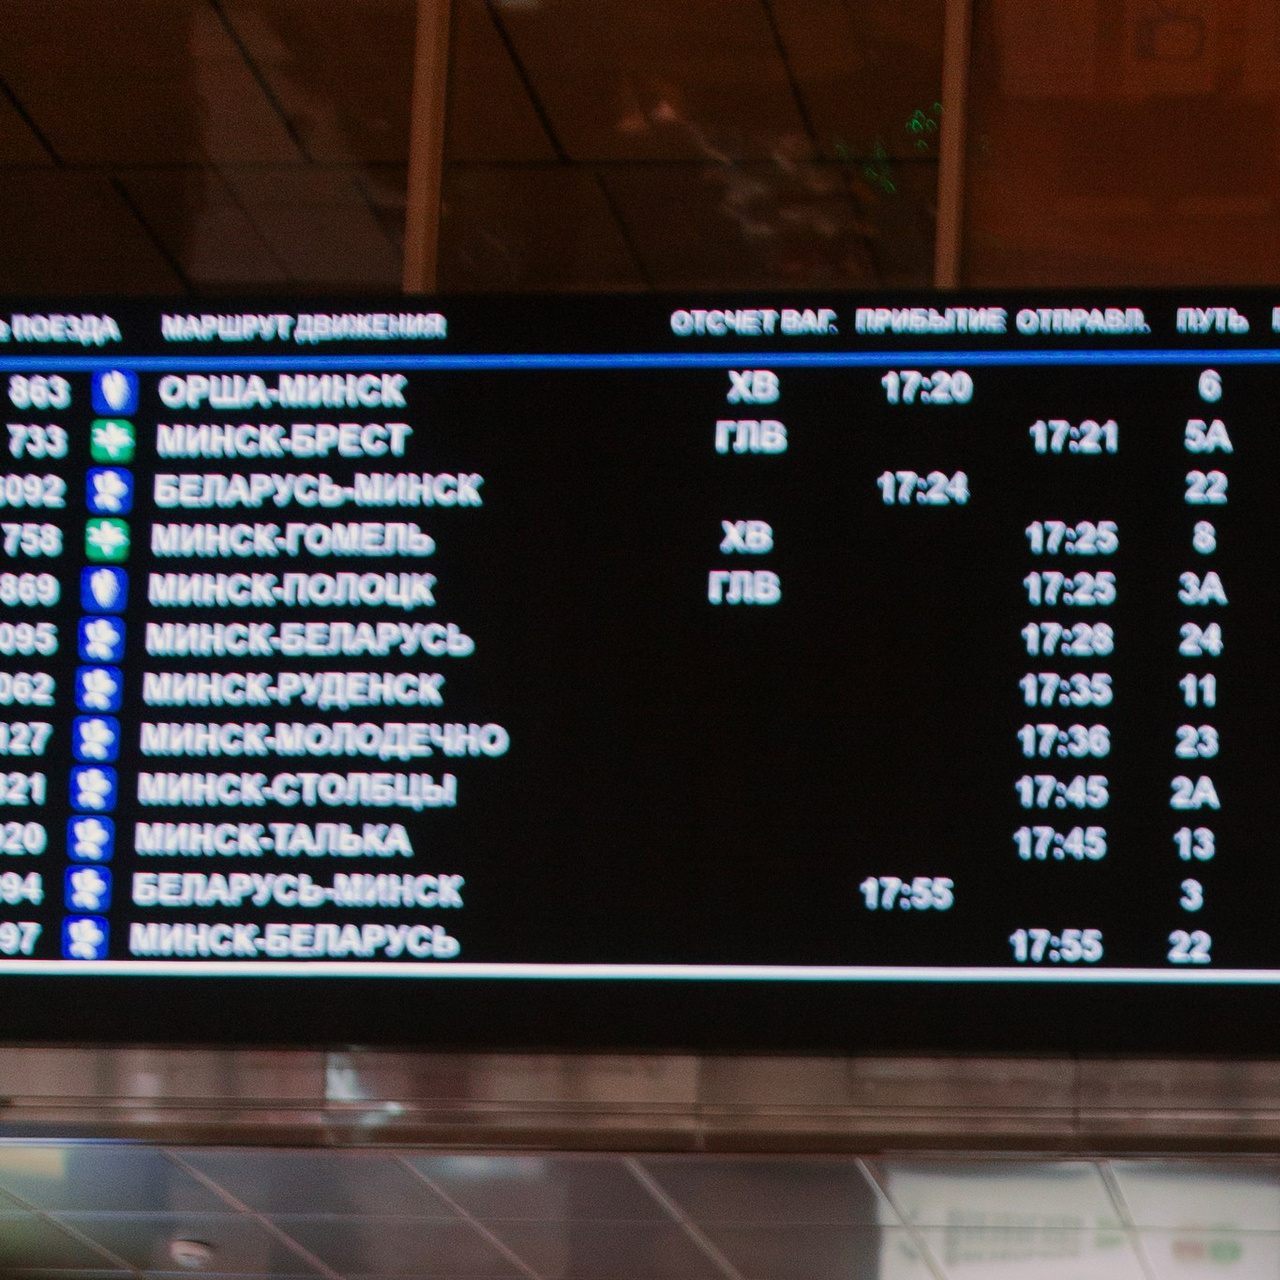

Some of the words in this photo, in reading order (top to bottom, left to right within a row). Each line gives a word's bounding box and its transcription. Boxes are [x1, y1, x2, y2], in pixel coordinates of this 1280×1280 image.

[12, 309, 121, 343] ПОЕЗДА
[161, 313, 295, 342] МАРШРУТ
[293, 312, 447, 345] ДВИЖЕНИЯ
[670, 308, 779, 334] ОТСЧЕТ
[780, 308, 838, 333] ВАГ.
[855, 308, 1007, 334] ПРИБЫТИЕ
[1015, 307, 1150, 333] ОТПРАВЛ.
[1177, 307, 1250, 331] ПУТЬ
[9, 374, 71, 409] 863
[159, 374, 408, 408] ОРША-МИНСК
[727, 370, 779, 402] ХВ
[882, 370, 974, 402] 17:20
[1199, 369, 1222, 400] 6
[7, 423, 67, 458] 733
[157, 423, 412, 457] МИНСК-БРЕСТ
[715, 419, 788, 452] ГЛВ
[1030, 419, 1118, 452] 17:21
[1185, 419, 1233, 452] 5А
[0, 473, 67, 508] 092
[154, 472, 484, 507] БЕЛАРУСЬ-МИНСК
[878, 470, 969, 503] 17:24
[1185, 470, 1228, 502] 22
[0, 522, 63, 557] 758
[151, 522, 435, 557] МИНСК-ГОМЕЛЬ
[720, 520, 774, 553] ХВ
[1026, 520, 1119, 554] 17:25
[1193, 520, 1217, 553] 8
[148, 572, 437, 608] МИНСК-ПОЛОЦК
[708, 570, 781, 604] ГЛВ
[1024, 571, 1117, 605] 17:25
[1179, 571, 1228, 604] 3А
[145, 622, 474, 656] МИНСК-БЕЛАРУСЬ
[1022, 622, 1114, 656] 17:28
[1180, 622, 1224, 656] 24
[143, 671, 444, 710] МИНСК-РУДЕНСК
[1020, 672, 1113, 706] 17:35
[1180, 673, 1216, 706] 11
[140, 722, 509, 761] МИНСК-МОЛОДЕЧНО
[1176, 724, 1219, 758] 23
[138, 772, 457, 809] МИНСК-СТОЛБЦЫ
[1016, 774, 1109, 808] 17:45
[1171, 775, 1221, 809] 2А
[135, 822, 413, 857] МИНСК-ТАЛЬКА
[1014, 825, 1107, 860] 17:45
[1174, 826, 1215, 860] 13
[132, 872, 464, 908] БЕЛАРУСЬ-МИНСК
[860, 876, 954, 910] 17:55
[1181, 878, 1204, 911] 3
[129, 922, 460, 957] МИНСК-БЕЛАРУСЬ
[1010, 928, 1103, 962] 17:55
[1169, 929, 1212, 963] 22
